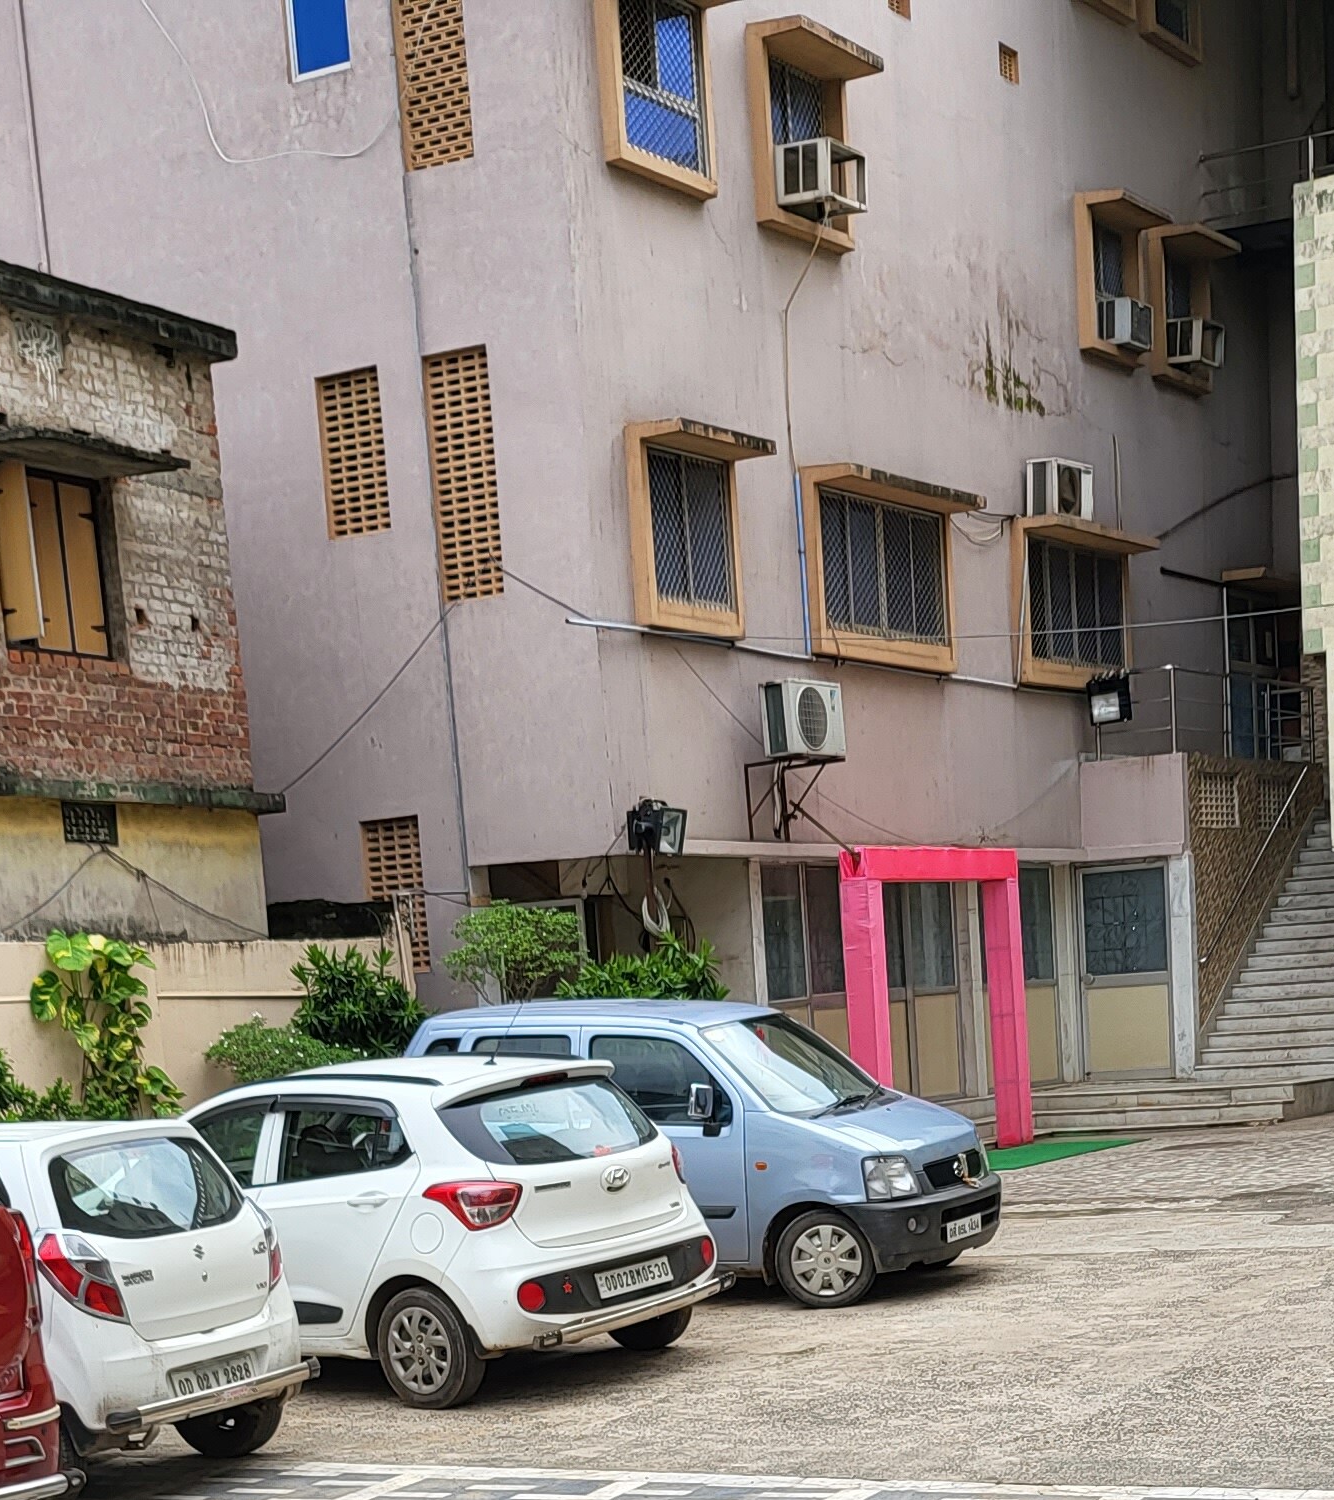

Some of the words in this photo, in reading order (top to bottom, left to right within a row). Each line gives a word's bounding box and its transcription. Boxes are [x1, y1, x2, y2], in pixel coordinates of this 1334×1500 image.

[604, 1262, 670, 1291] OD02BM0530
[196, 1373, 212, 1391] 02
[223, 1362, 252, 1384] 2828
